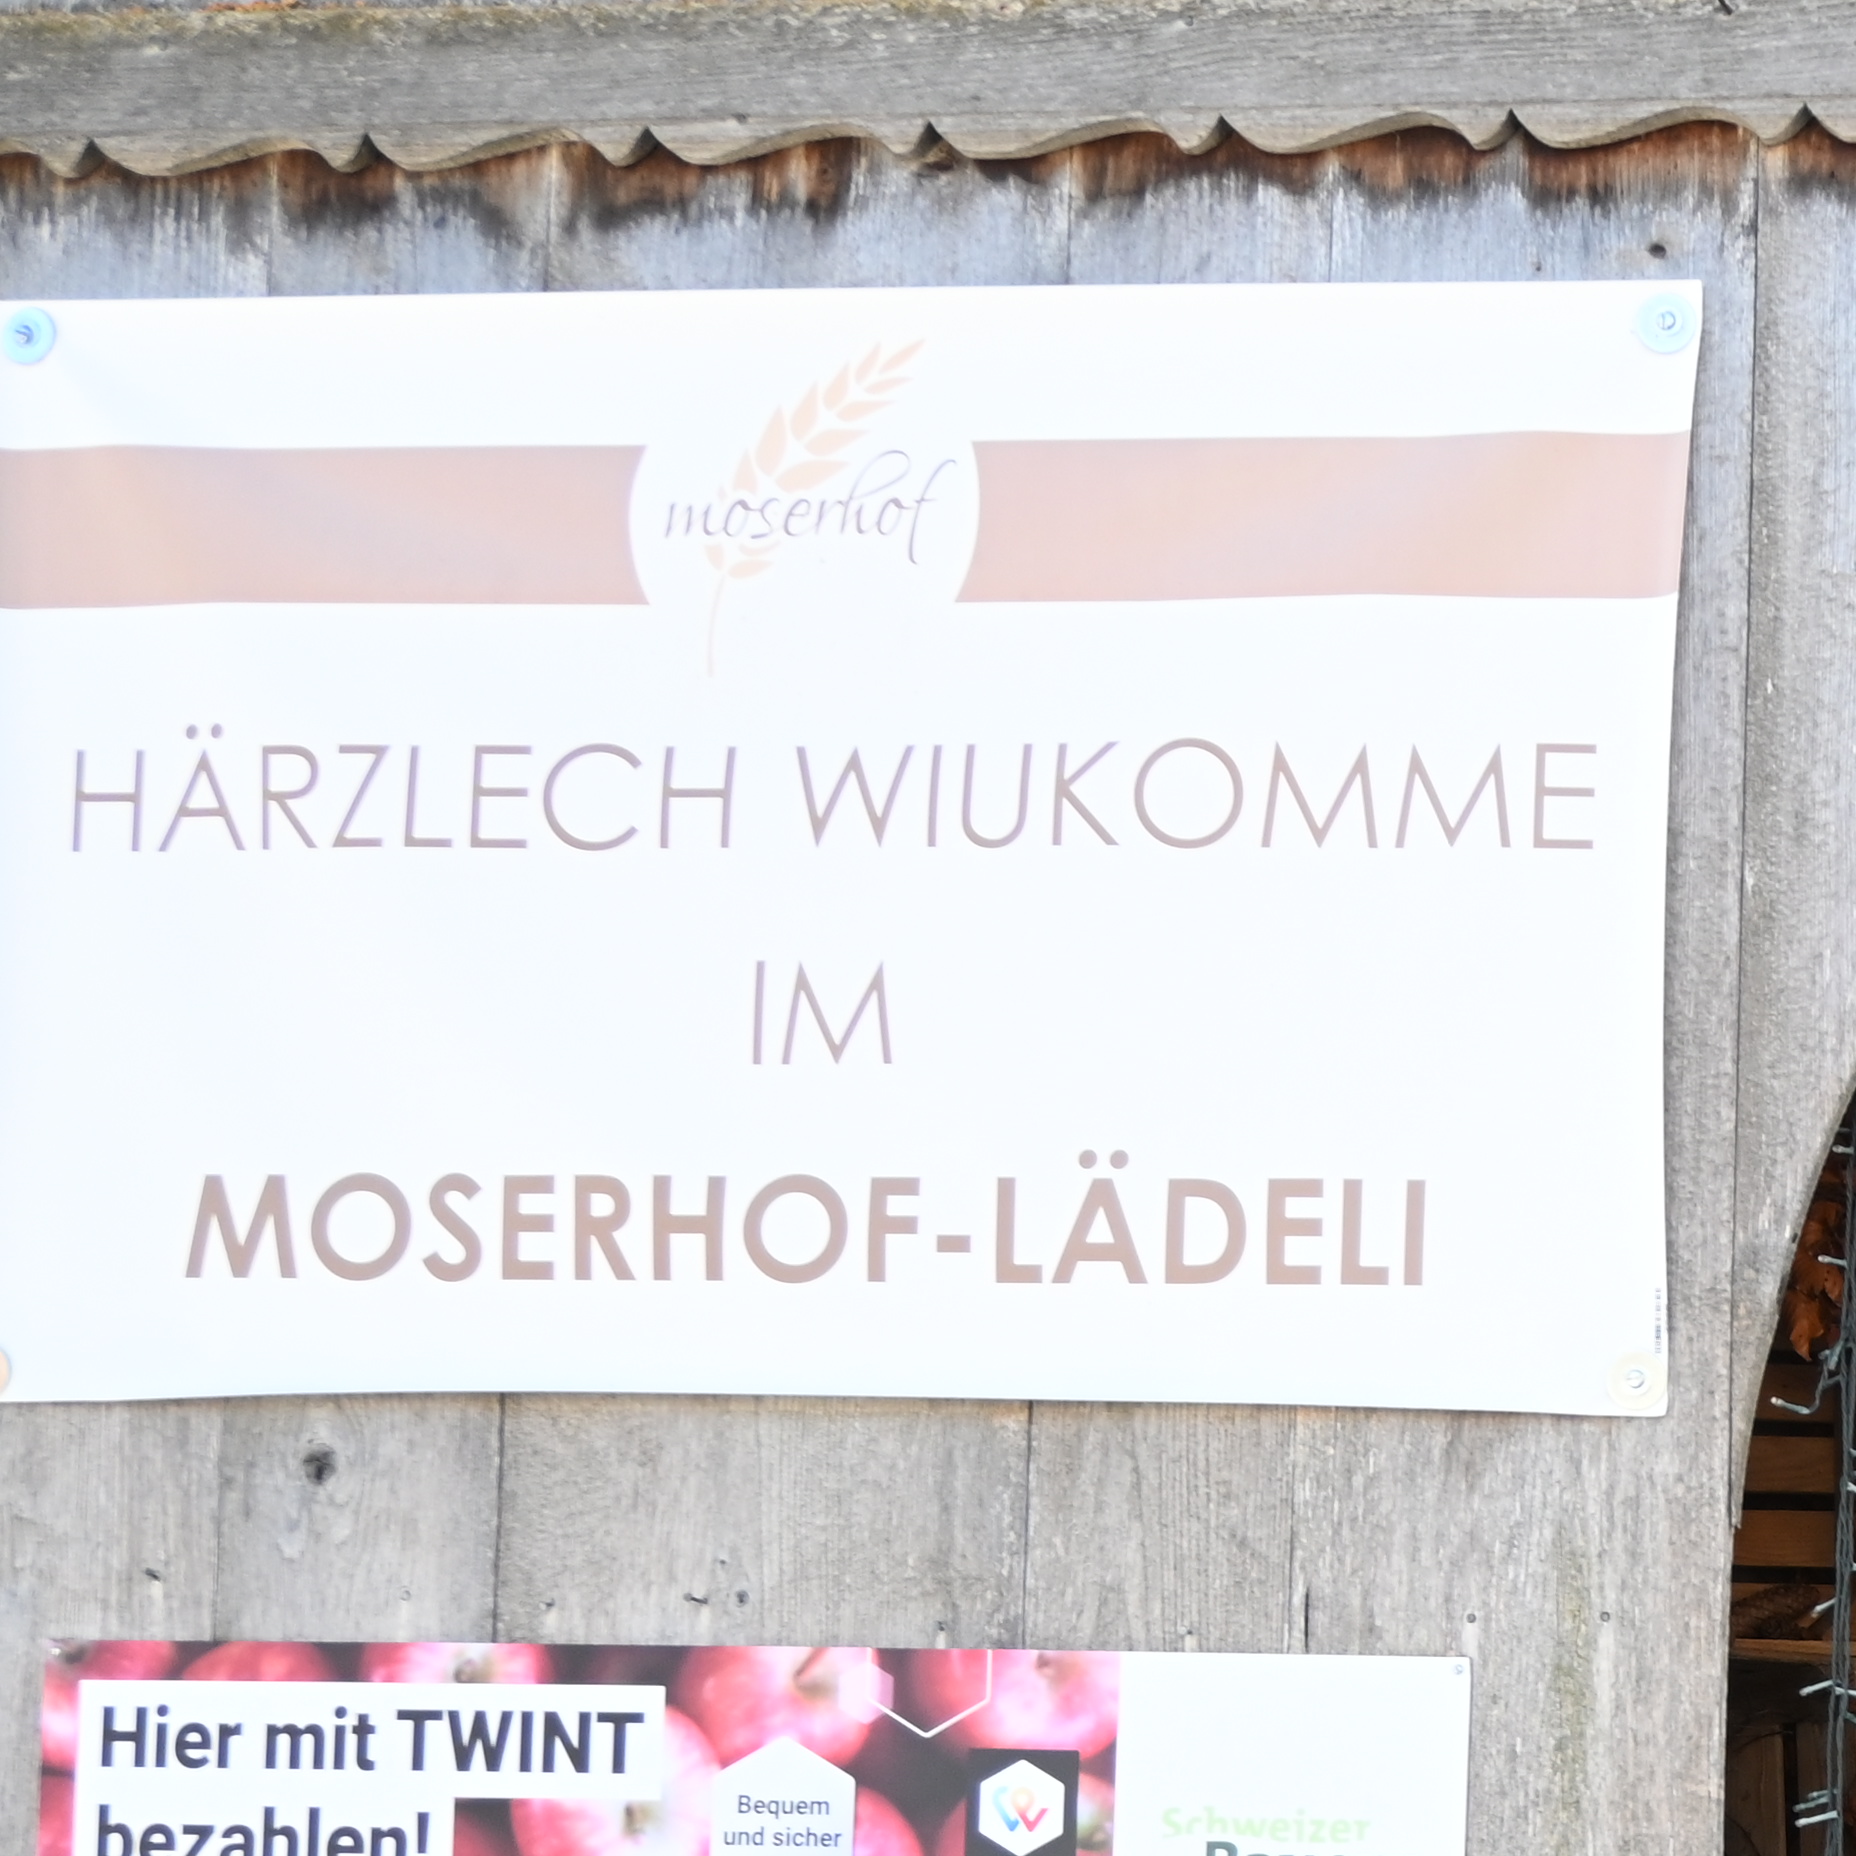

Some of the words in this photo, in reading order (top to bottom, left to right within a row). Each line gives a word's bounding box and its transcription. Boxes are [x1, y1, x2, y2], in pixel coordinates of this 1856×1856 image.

[663, 449, 958, 565] moserhof
[72, 723, 738, 853] HÄRZLECH
[796, 736, 1598, 851] WIUKOMME
[752, 960, 893, 1066] IM
[185, 1149, 1428, 1286] MOSERHOF-LÄDELI
[100, 1705, 242, 1769] Hier
[265, 1707, 376, 1772] mit
[397, 1708, 645, 1775] TWINT
[722, 1826, 770, 1849] und
[772, 1826, 843, 1850] sicher
[737, 1794, 831, 1820] Bequem
[1161, 1804, 1372, 1845] Schweizer
